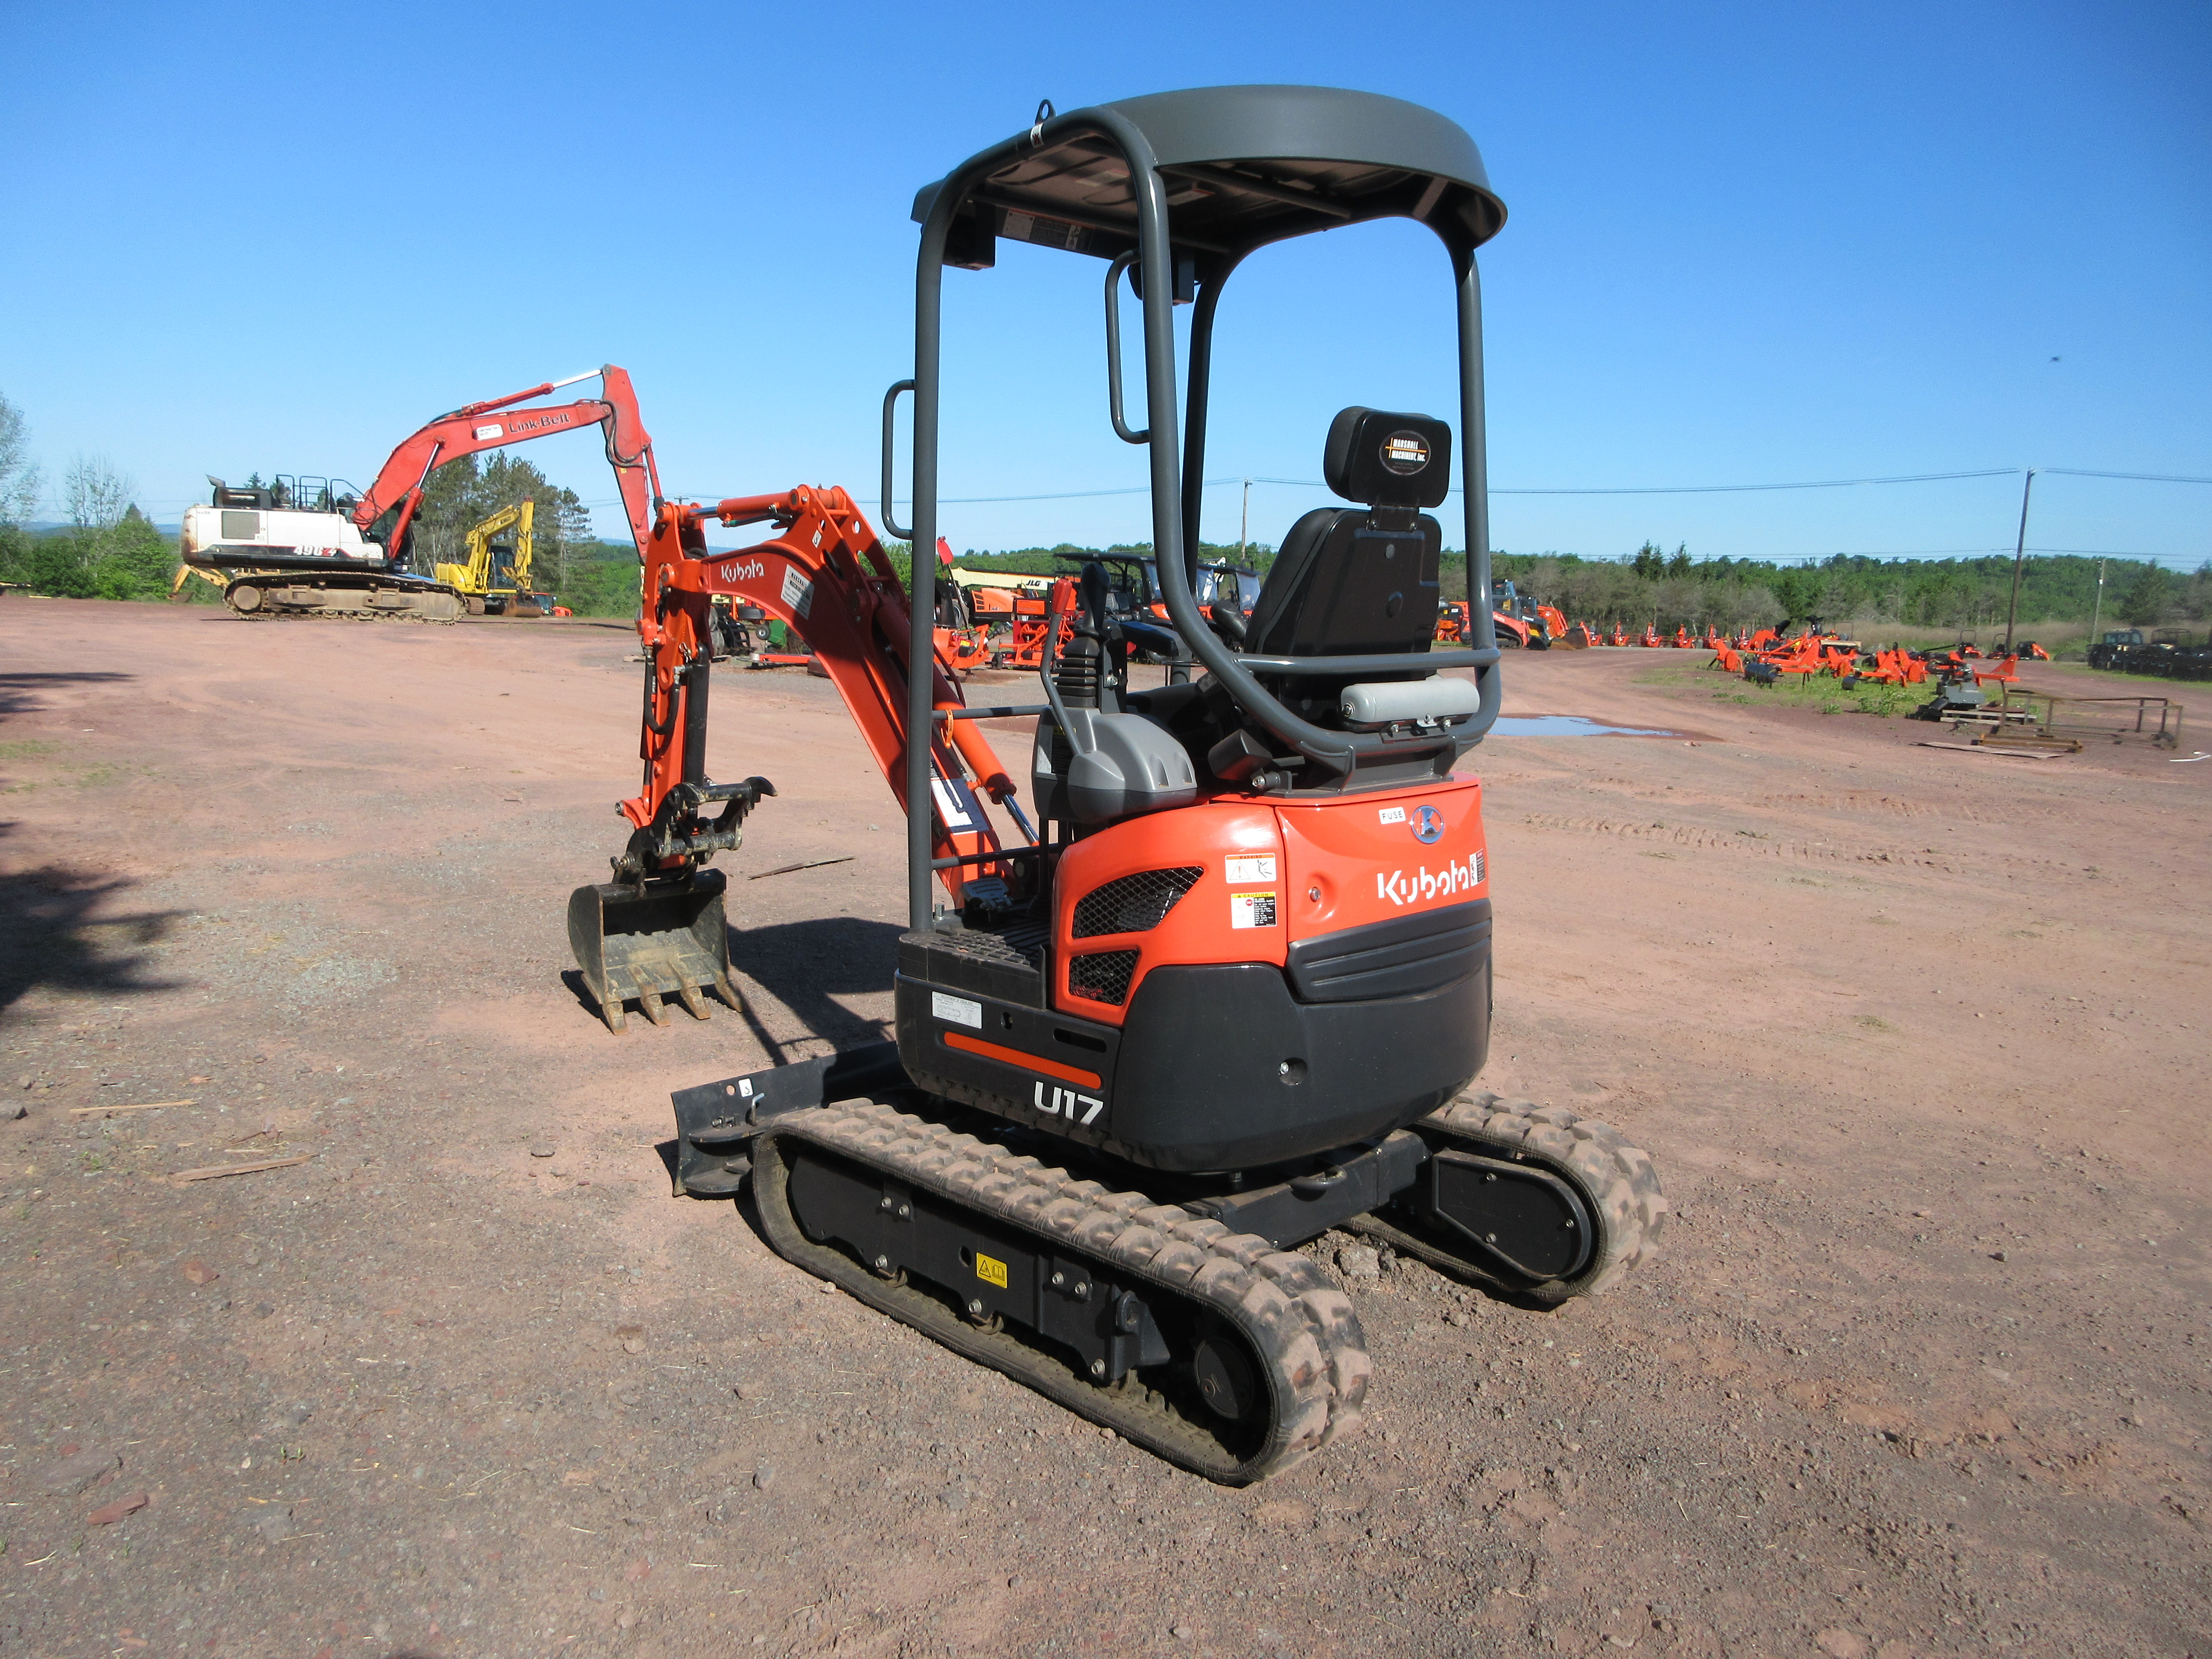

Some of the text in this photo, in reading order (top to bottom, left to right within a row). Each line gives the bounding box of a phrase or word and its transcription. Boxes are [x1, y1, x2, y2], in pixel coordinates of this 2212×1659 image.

[1393, 439, 1418, 449] MARSHALL
[1417, 453, 1426, 462] Inc.
[721, 559, 764, 582] Kubota
[1382, 811, 1403, 821] FUSE
[1377, 859, 1469, 905] Kubota
[1035, 1081, 1103, 1125] U17
